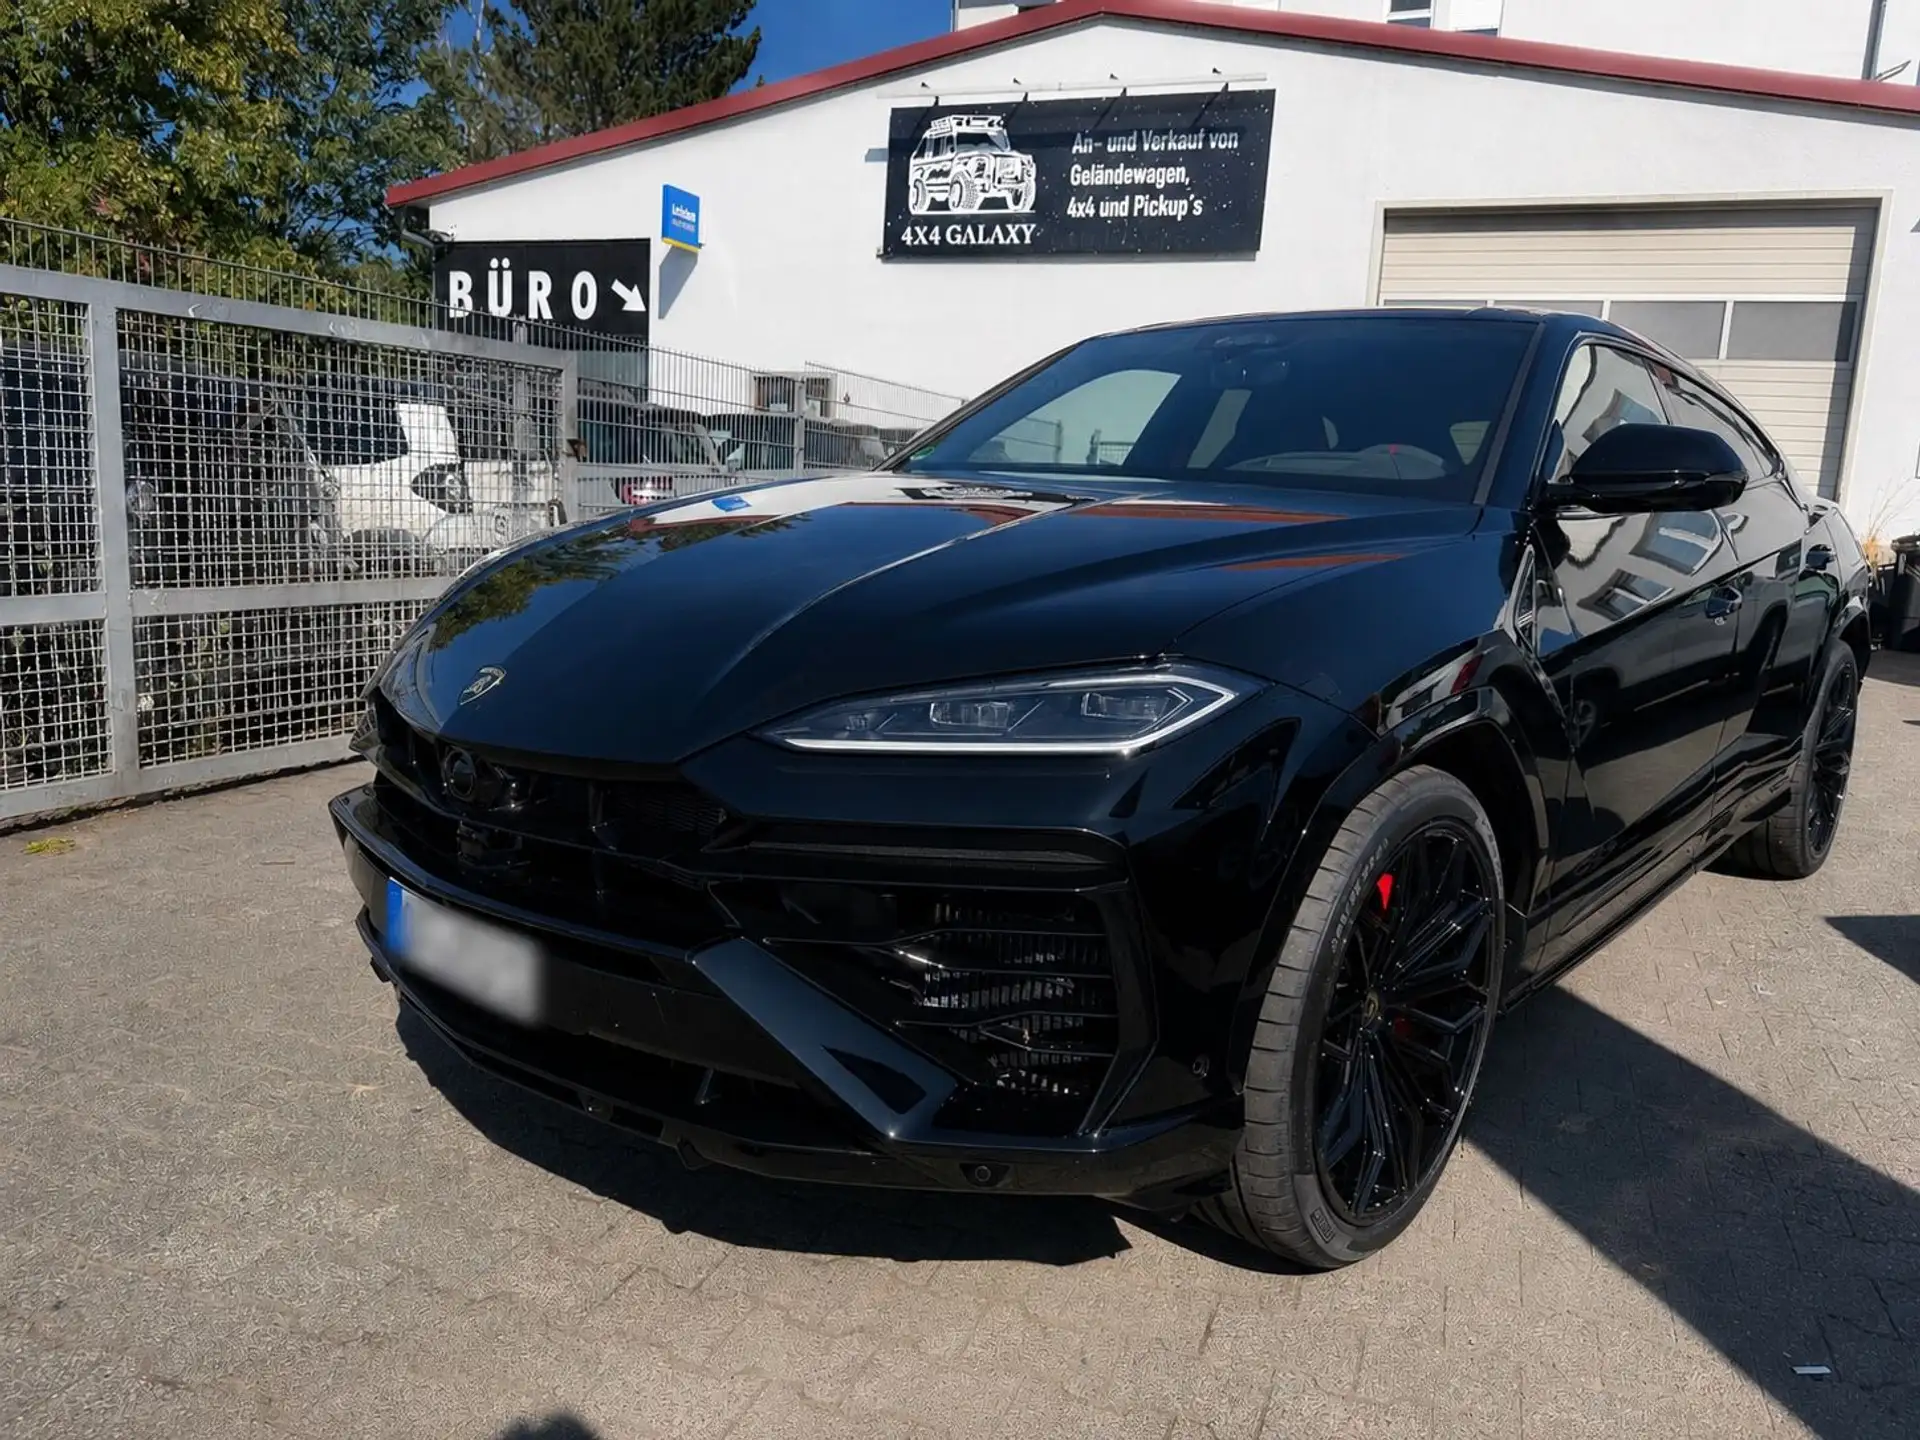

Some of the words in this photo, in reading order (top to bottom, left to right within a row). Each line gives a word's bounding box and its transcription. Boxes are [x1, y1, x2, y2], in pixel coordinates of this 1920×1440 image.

[1072, 132, 1103, 154] An-
[1107, 130, 1138, 152] und
[1142, 128, 1205, 151] Verkauf
[1209, 132, 1239, 149] von
[1070, 163, 1190, 189] Geländewagen,
[1067, 196, 1096, 218] 4x4
[1100, 195, 1130, 217] und
[901, 226, 942, 246] 4X4
[945, 224, 1037, 245] GALAXY
[449, 257, 598, 320] BÜRO
